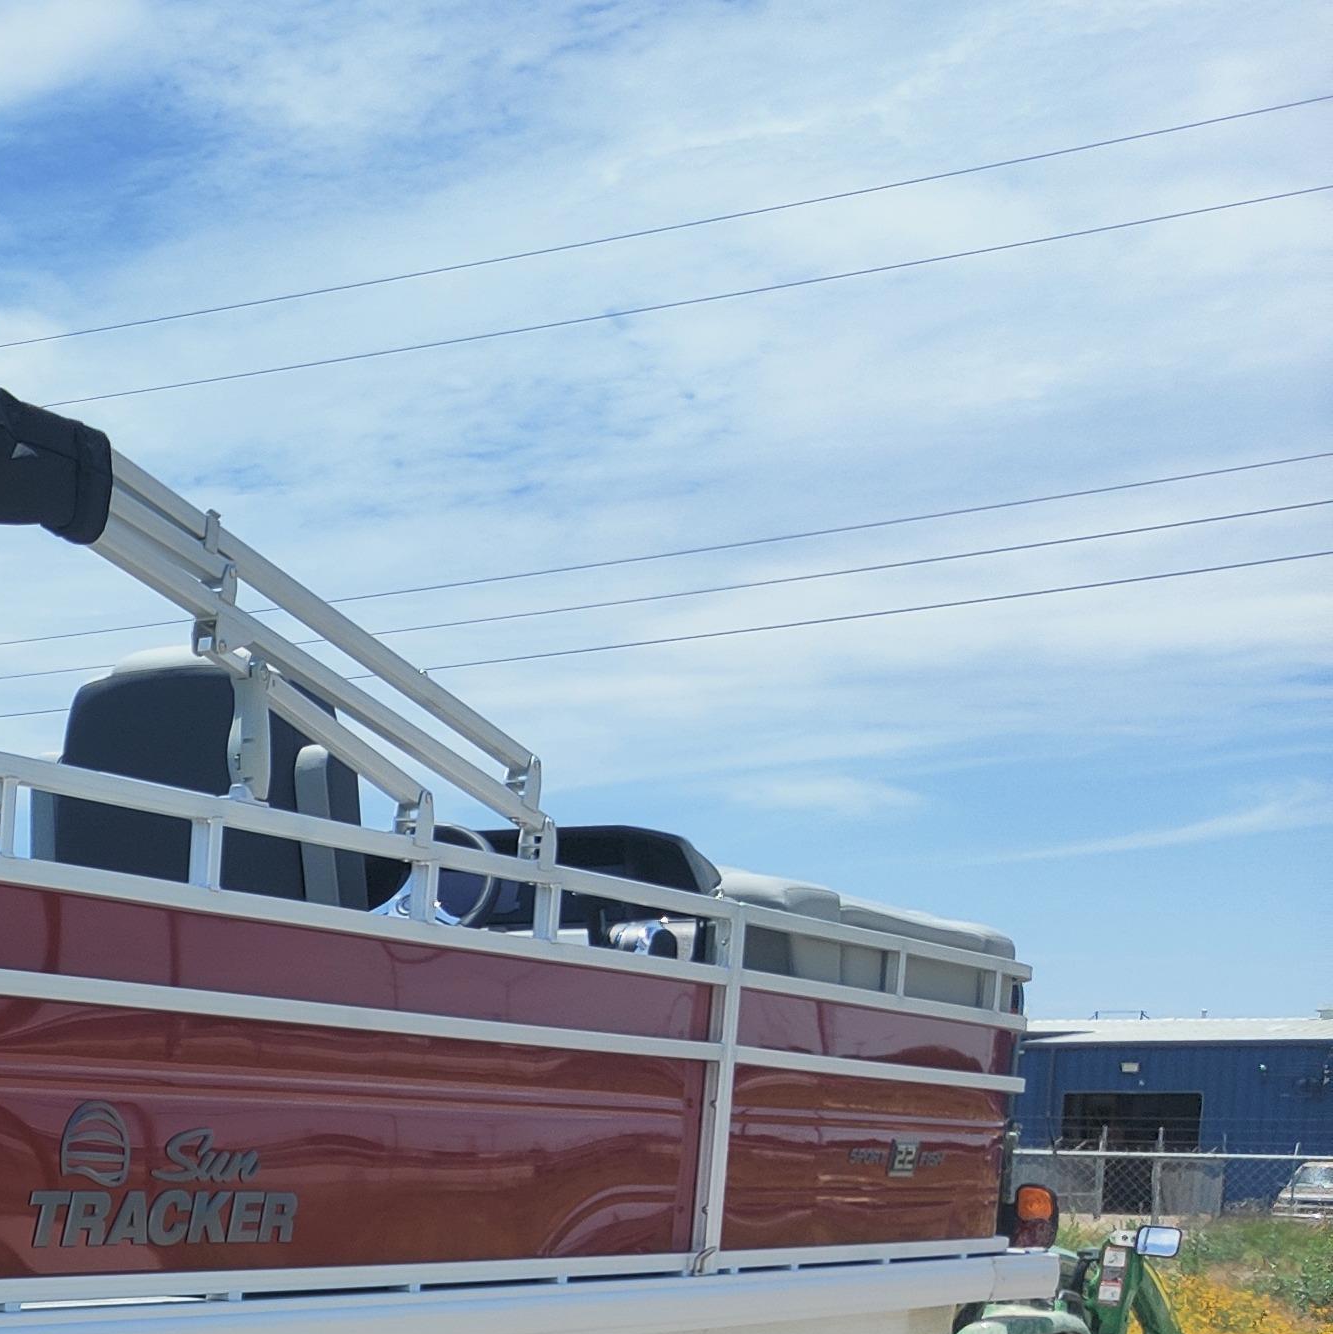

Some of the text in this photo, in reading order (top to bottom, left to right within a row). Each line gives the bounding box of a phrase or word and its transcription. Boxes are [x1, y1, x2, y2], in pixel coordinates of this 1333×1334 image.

[151, 1128, 260, 1183] Sun
[894, 1144, 916, 1170] 22
[29, 1190, 298, 1248] TRACKER
